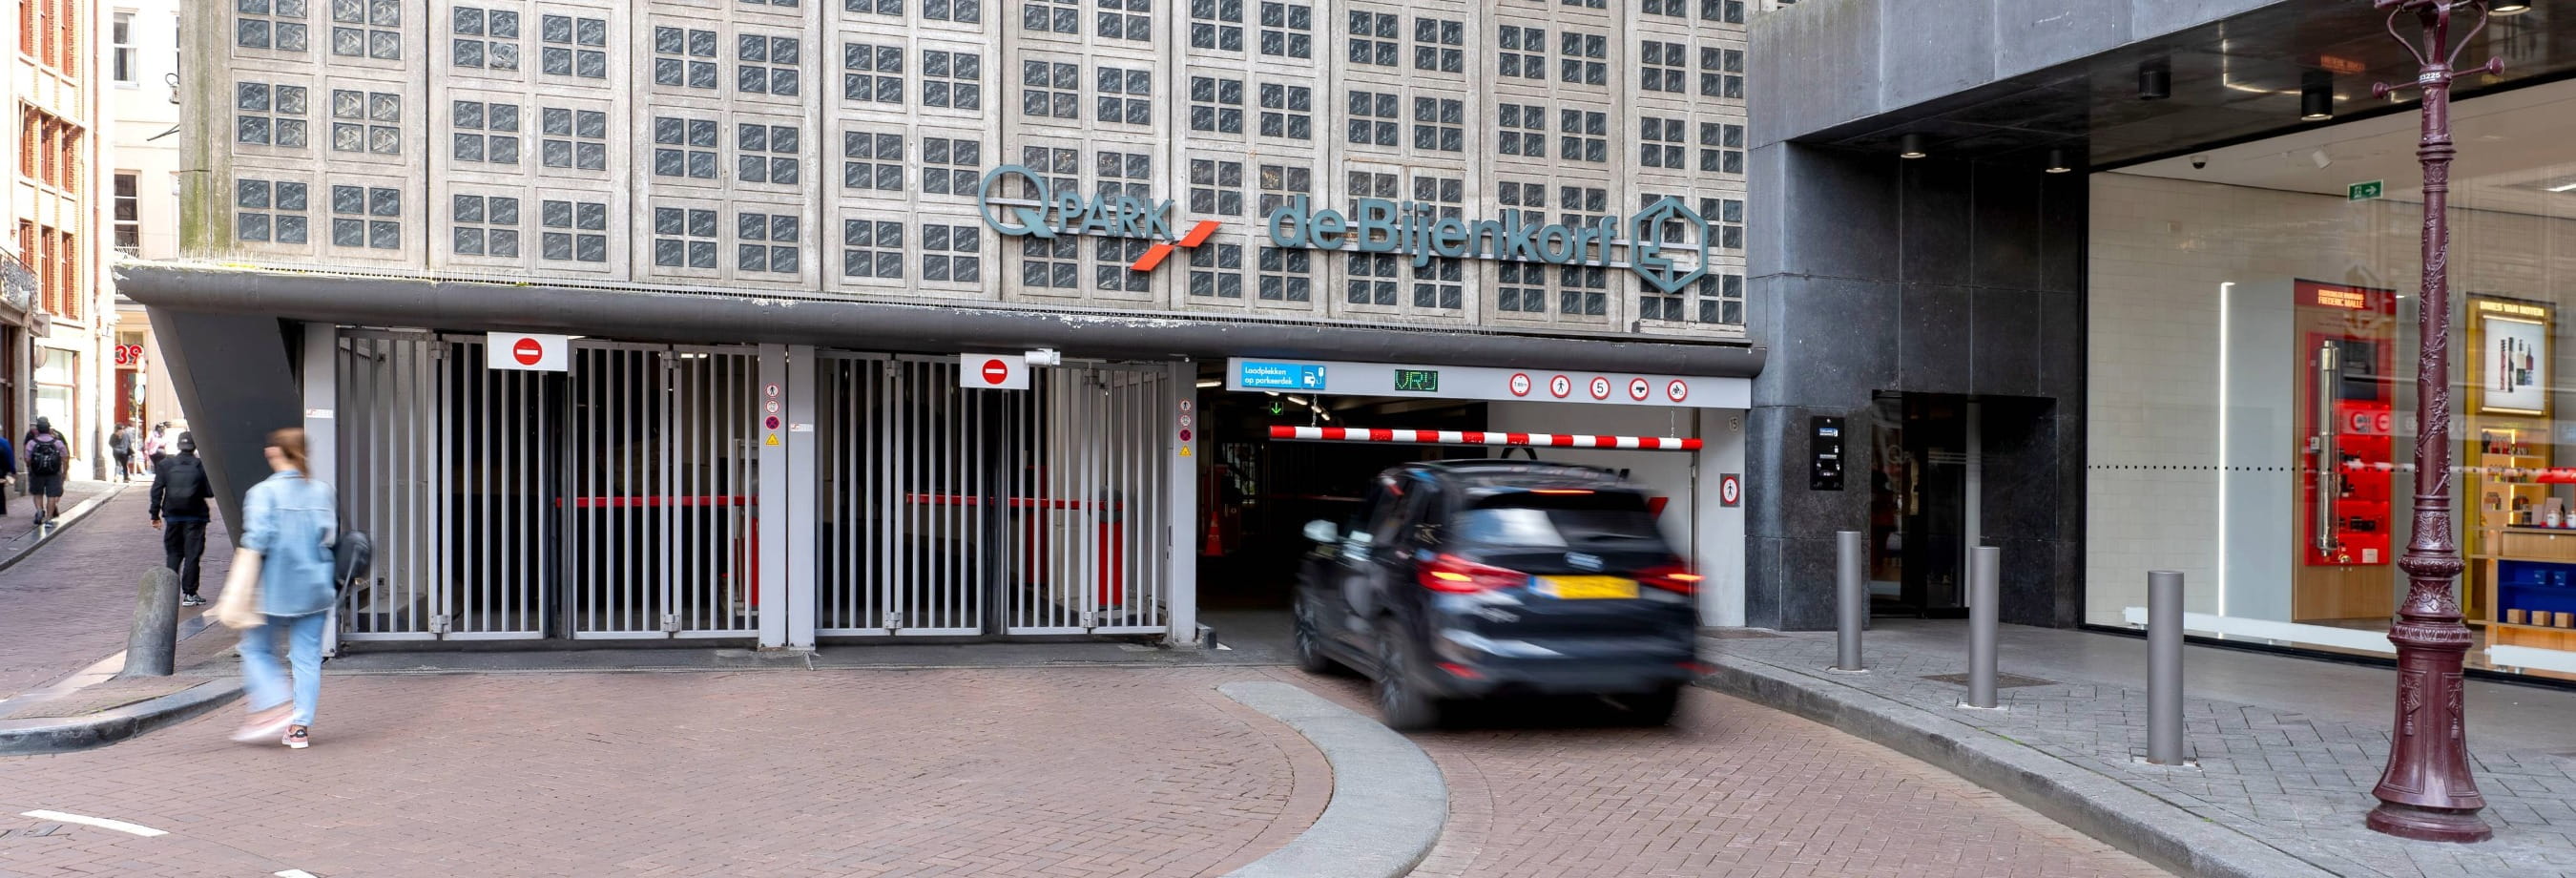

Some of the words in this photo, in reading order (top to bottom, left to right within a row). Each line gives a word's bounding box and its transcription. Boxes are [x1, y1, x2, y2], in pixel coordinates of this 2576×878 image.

[1269, 194, 1346, 250] de
[1359, 198, 1617, 267] Bijenkorf
[1244, 366, 1287, 376] Laadplekken
[1244, 377, 1255, 386] op
[1256, 376, 1293, 386] parkeerdek
[1596, 383, 1604, 393] 5
[1730, 418, 1737, 429] 15
